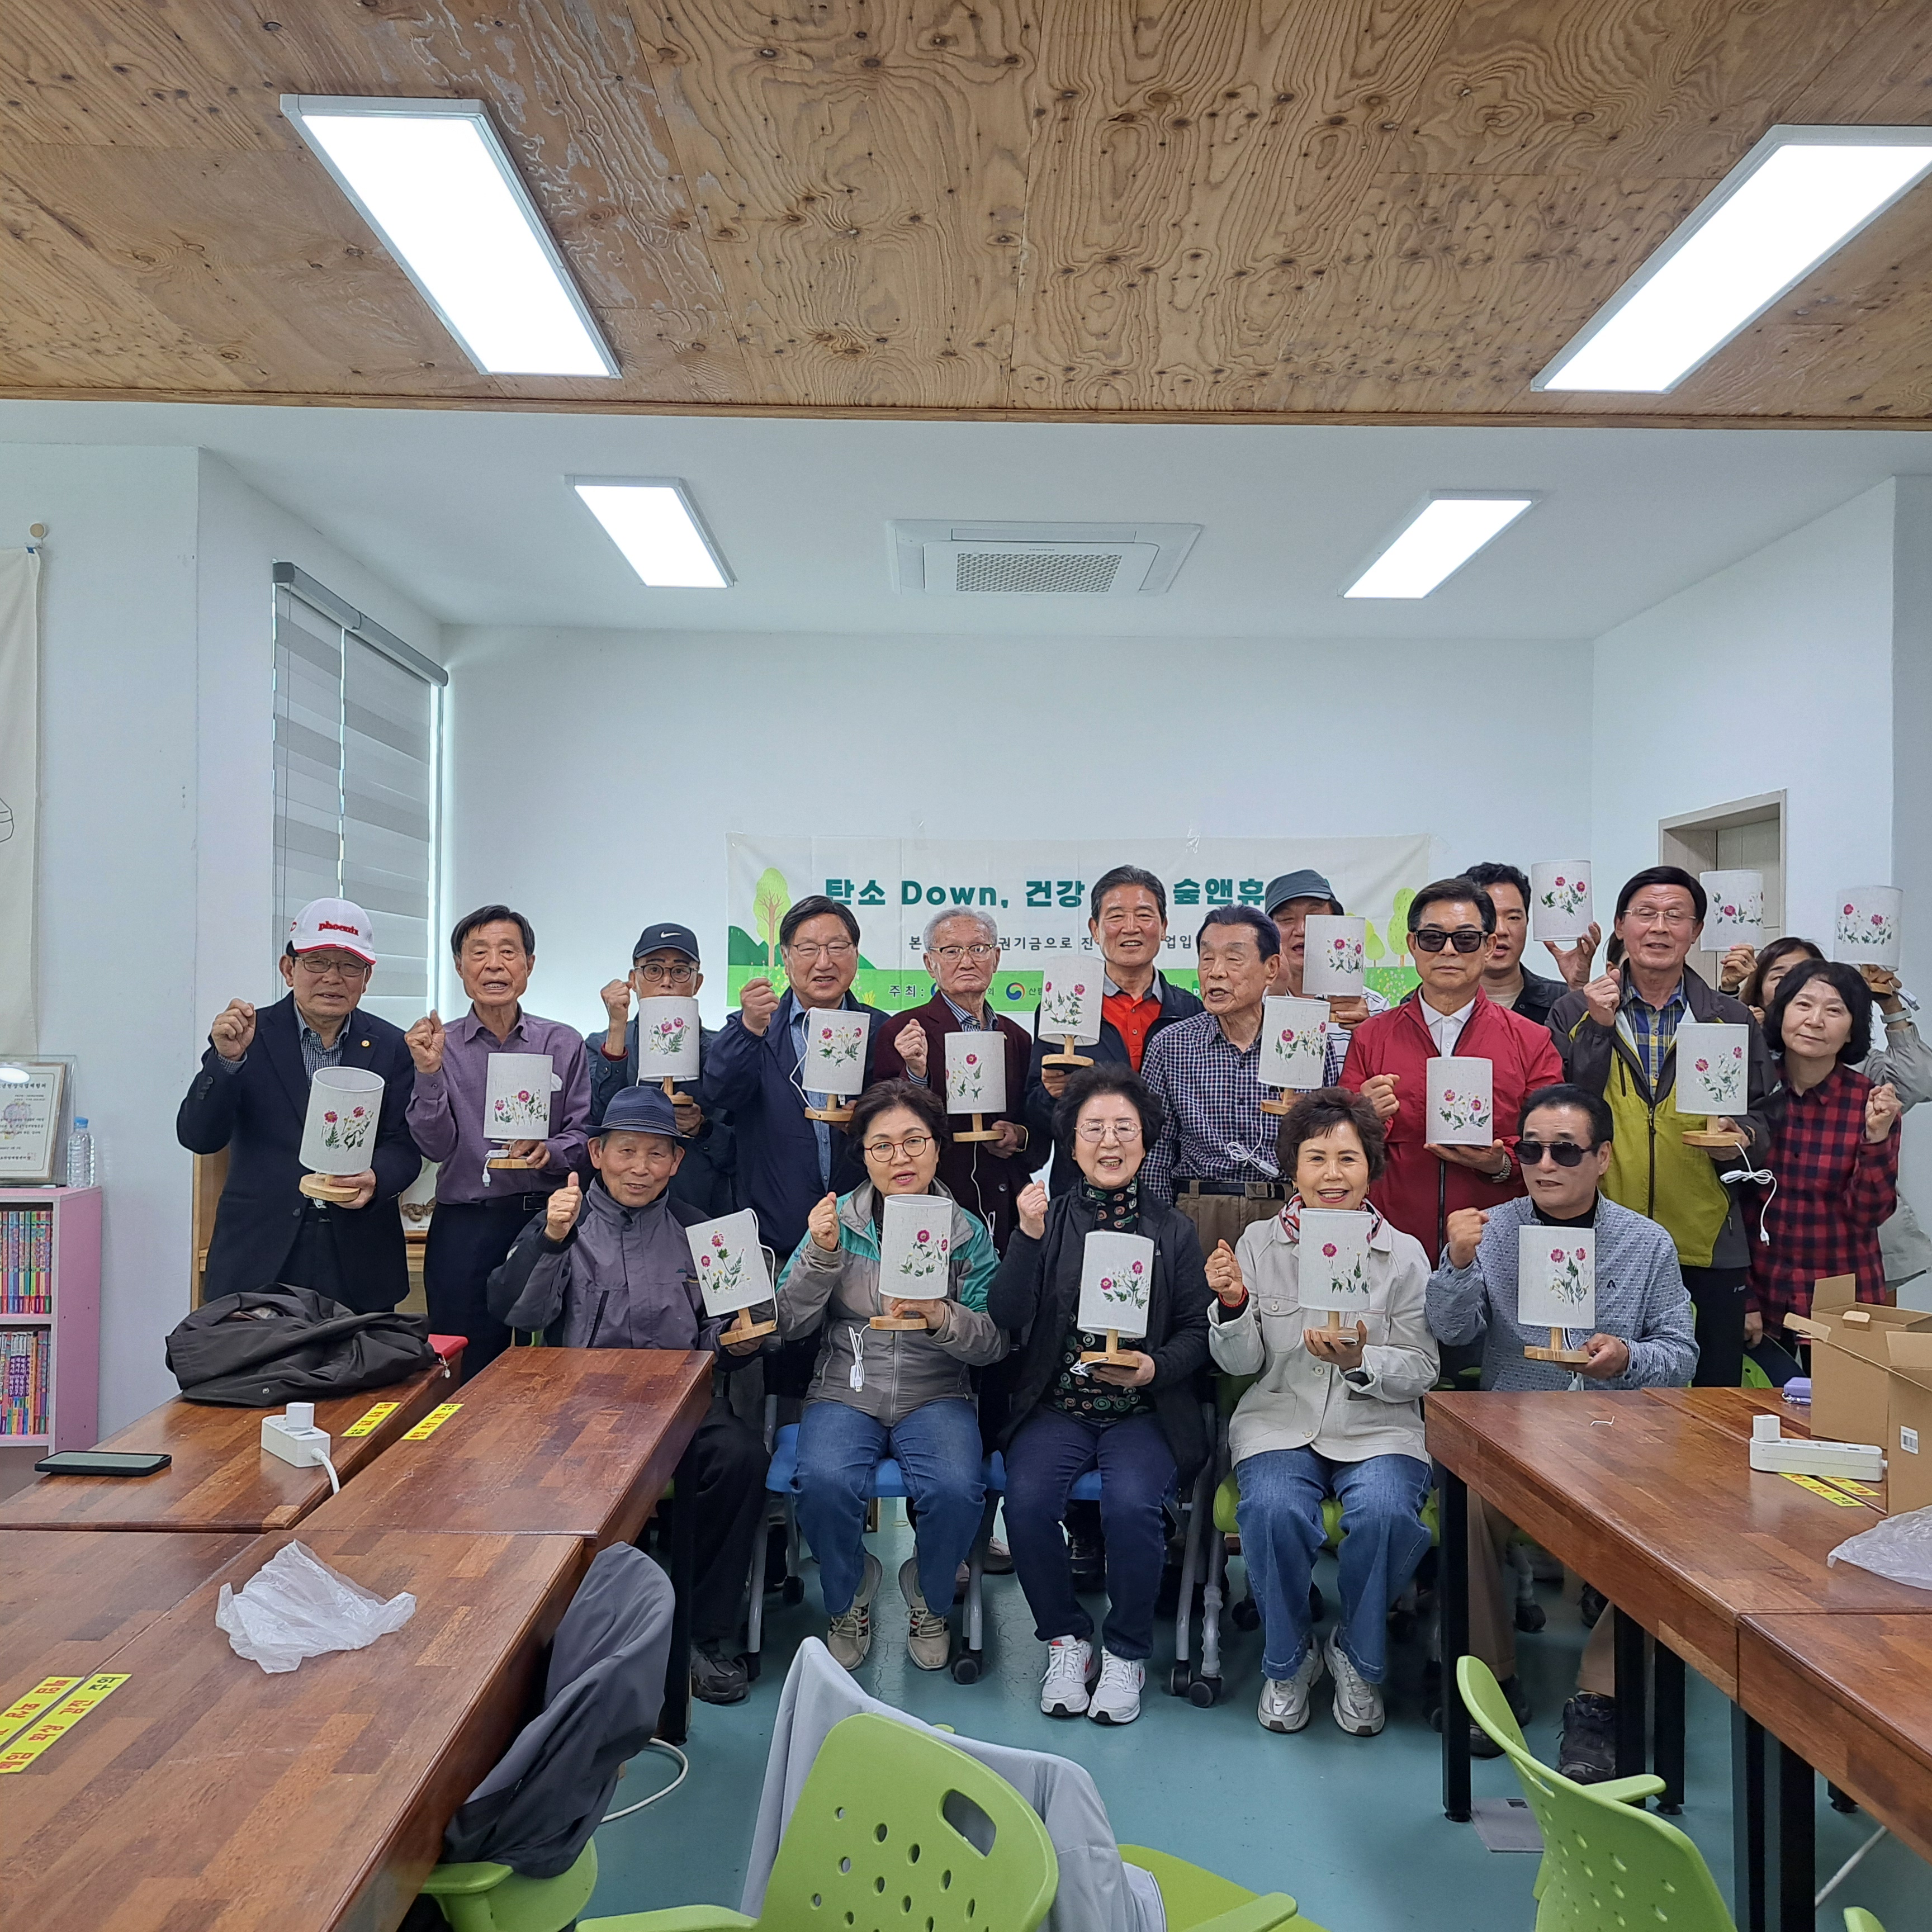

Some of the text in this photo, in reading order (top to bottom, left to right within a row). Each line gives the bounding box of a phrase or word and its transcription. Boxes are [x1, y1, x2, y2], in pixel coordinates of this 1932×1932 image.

[826, 879, 886, 905] 탄소
[901, 880, 1008, 908] Down,
[1025, 880, 1086, 908] 건강
[318, 921, 359, 936] phoenix
[908, 936, 922, 950] 본
[4, 1703, 41, 1718] 화상
[28, 1725, 65, 1741] 화상
[58, 1700, 96, 1715] 감전
[87, 1677, 122, 1690] 주의
